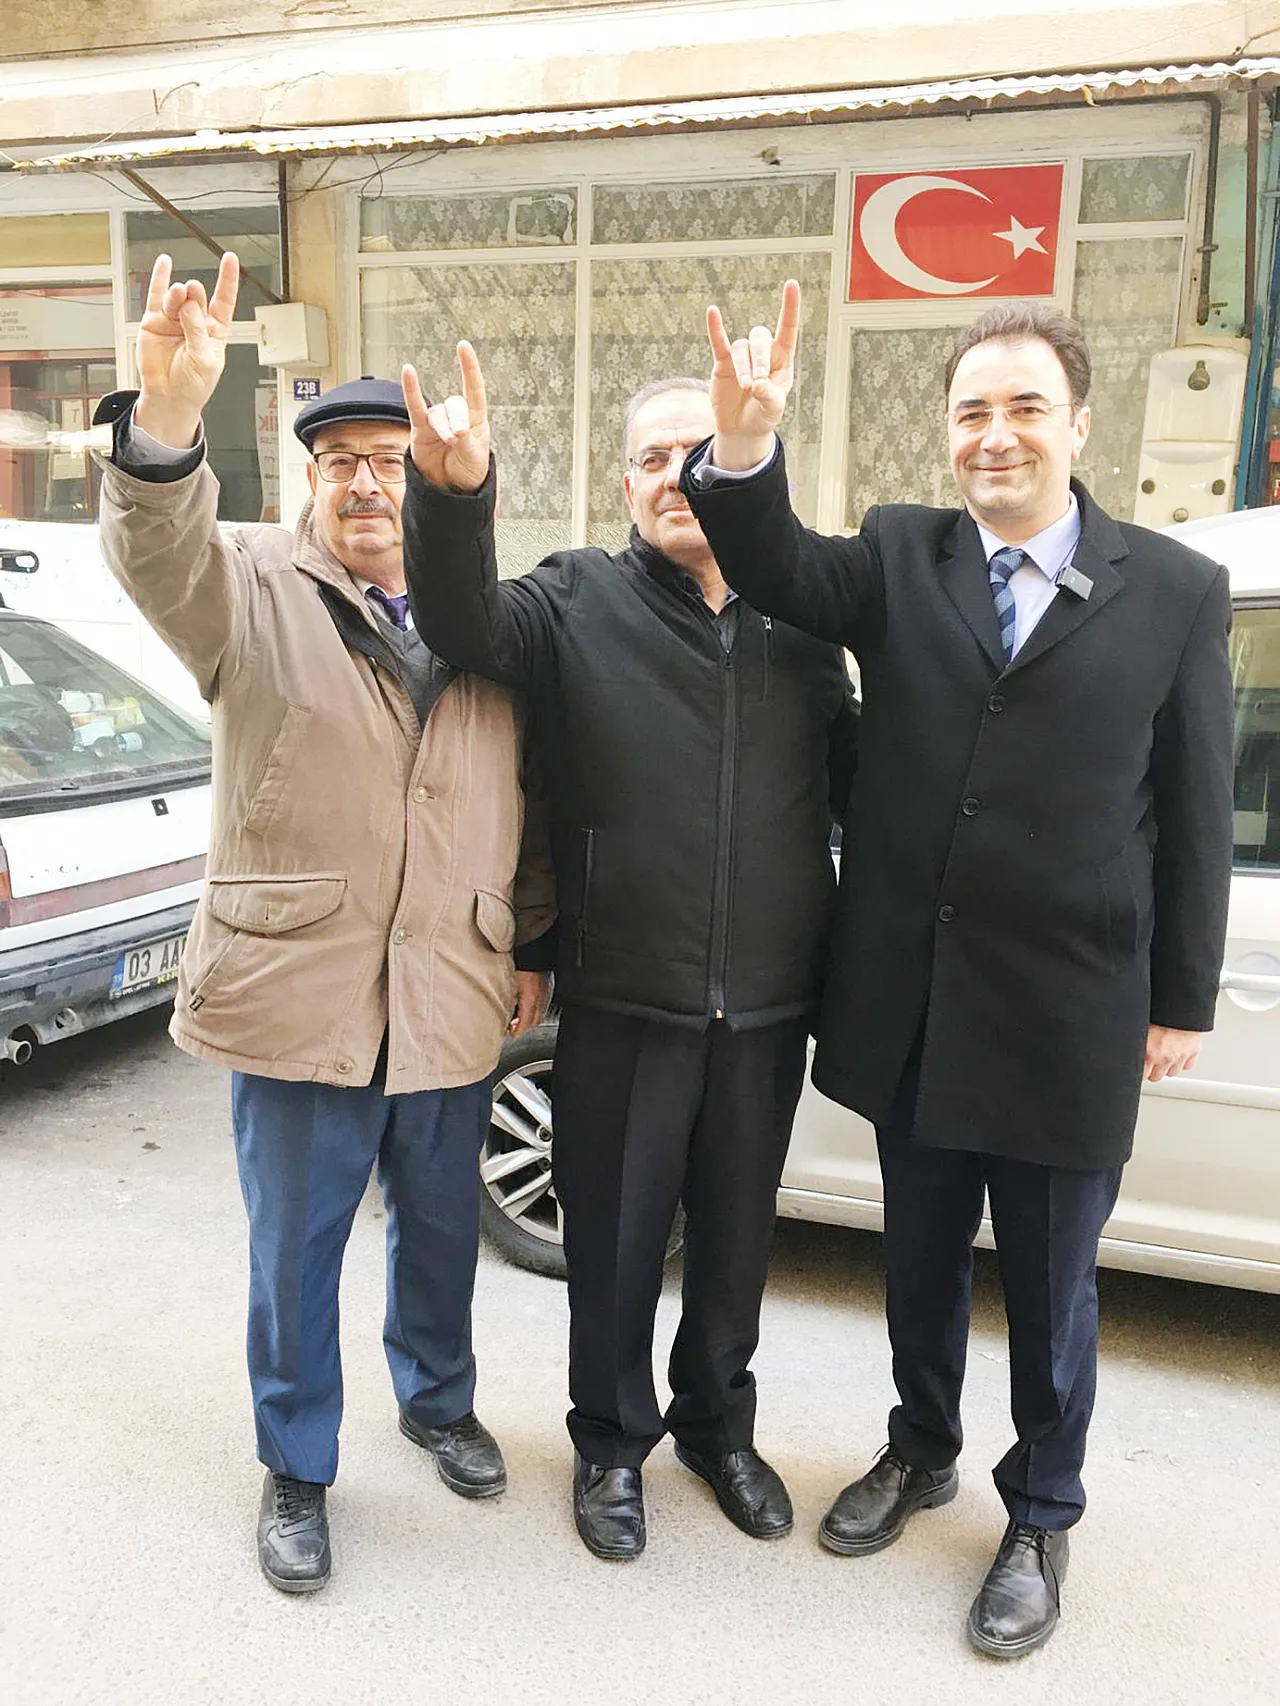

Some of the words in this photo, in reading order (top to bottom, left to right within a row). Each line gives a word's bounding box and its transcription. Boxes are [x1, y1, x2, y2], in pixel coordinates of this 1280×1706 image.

[296, 381, 317, 395] 23B
[129, 949, 151, 980] 03
[160, 936, 187, 973] AA
